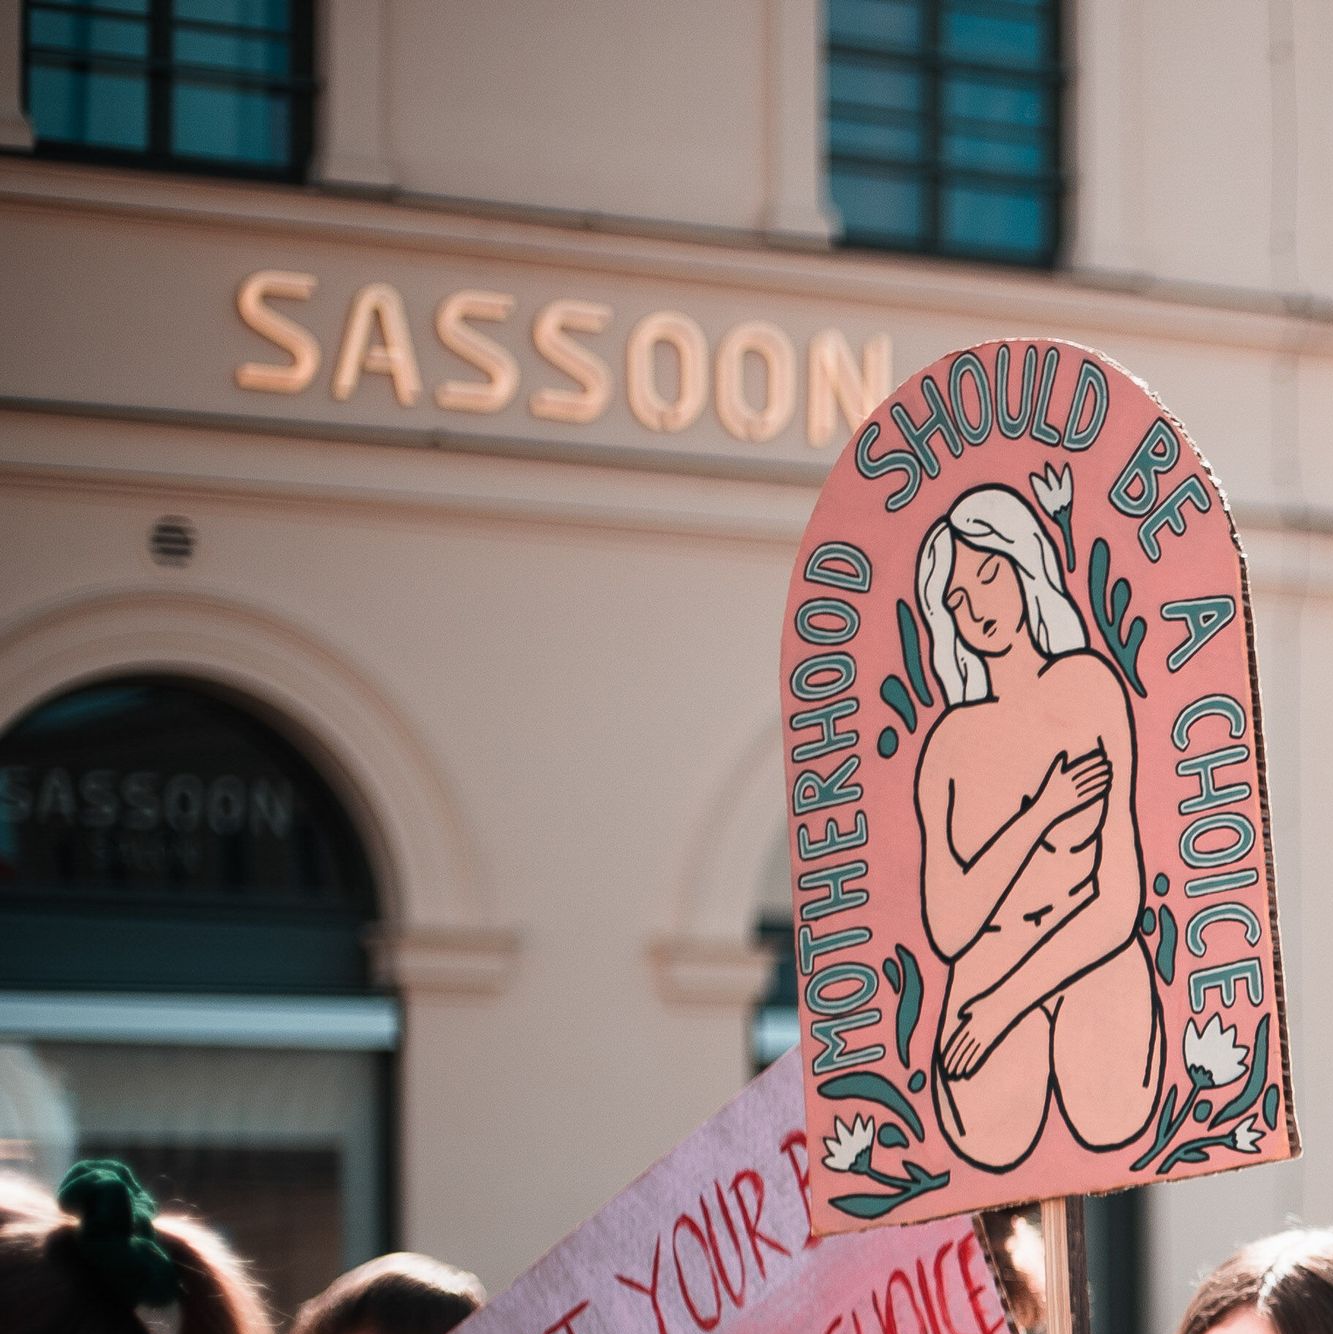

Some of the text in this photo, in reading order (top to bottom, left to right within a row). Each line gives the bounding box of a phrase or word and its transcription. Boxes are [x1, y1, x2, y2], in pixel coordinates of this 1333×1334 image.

[234, 268, 892, 450] SASSOON
[856, 343, 1109, 512] SHOULD
[1109, 418, 1211, 565] BE
[1160, 594, 1235, 674] A
[790, 541, 885, 1074] MOTHERHOOD
[1171, 694, 1265, 1015] CHOICE
